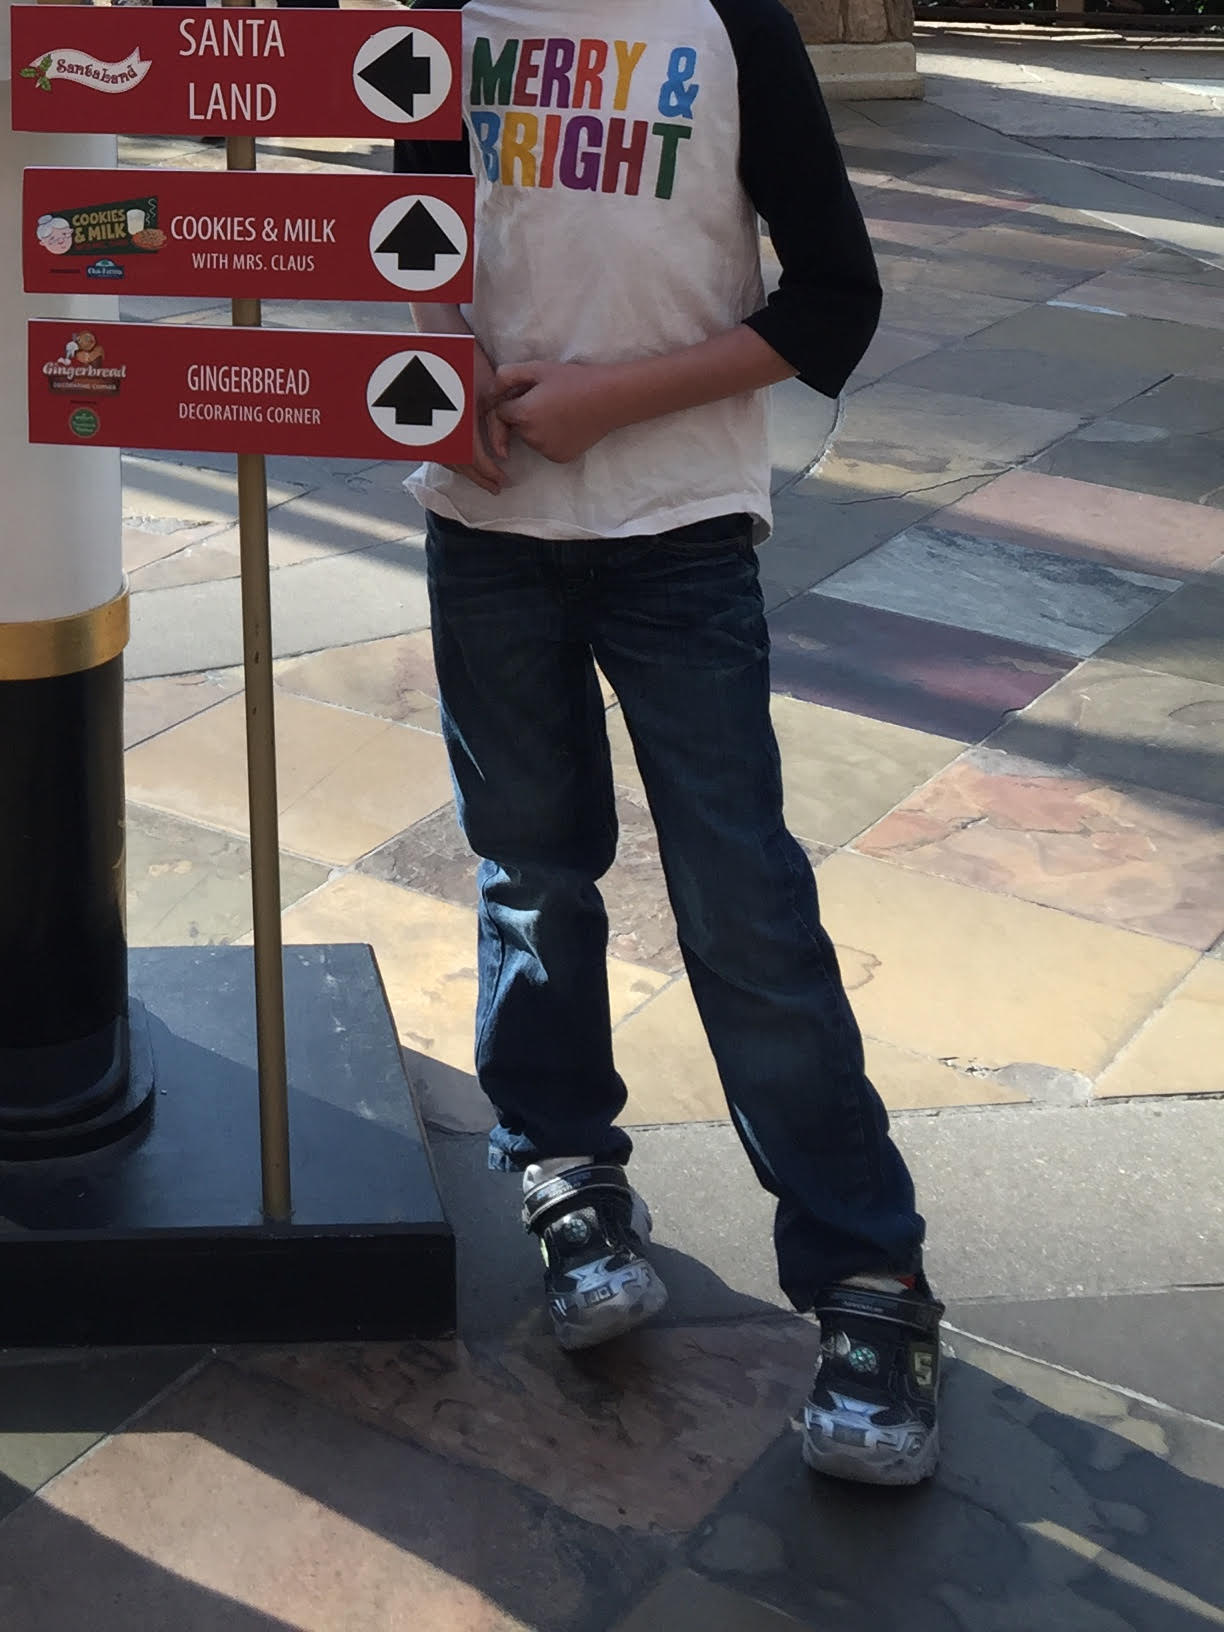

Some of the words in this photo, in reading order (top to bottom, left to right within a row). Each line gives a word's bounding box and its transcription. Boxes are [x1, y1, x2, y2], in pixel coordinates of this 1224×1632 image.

[179, 18, 285, 58] SANTA
[470, 37, 647, 110] MERRY
[658, 47, 699, 120] &
[189, 82, 277, 122] LAND
[470, 111, 693, 200] BRIGHT
[72, 209, 126, 226] COOKIES
[88, 222, 127, 241] MILK
[170, 215, 256, 241] COOKIES
[261, 217, 278, 242] &
[283, 218, 336, 243] MILK
[192, 252, 230, 270] WITH
[233, 253, 267, 270] MRS.
[271, 254, 315, 272] CLAUS
[42, 362, 127, 380] Gingerbread
[187, 364, 310, 396] GINGERBREAD
[179, 403, 264, 423] DECORATING
[267, 406, 321, 425] CORNER
